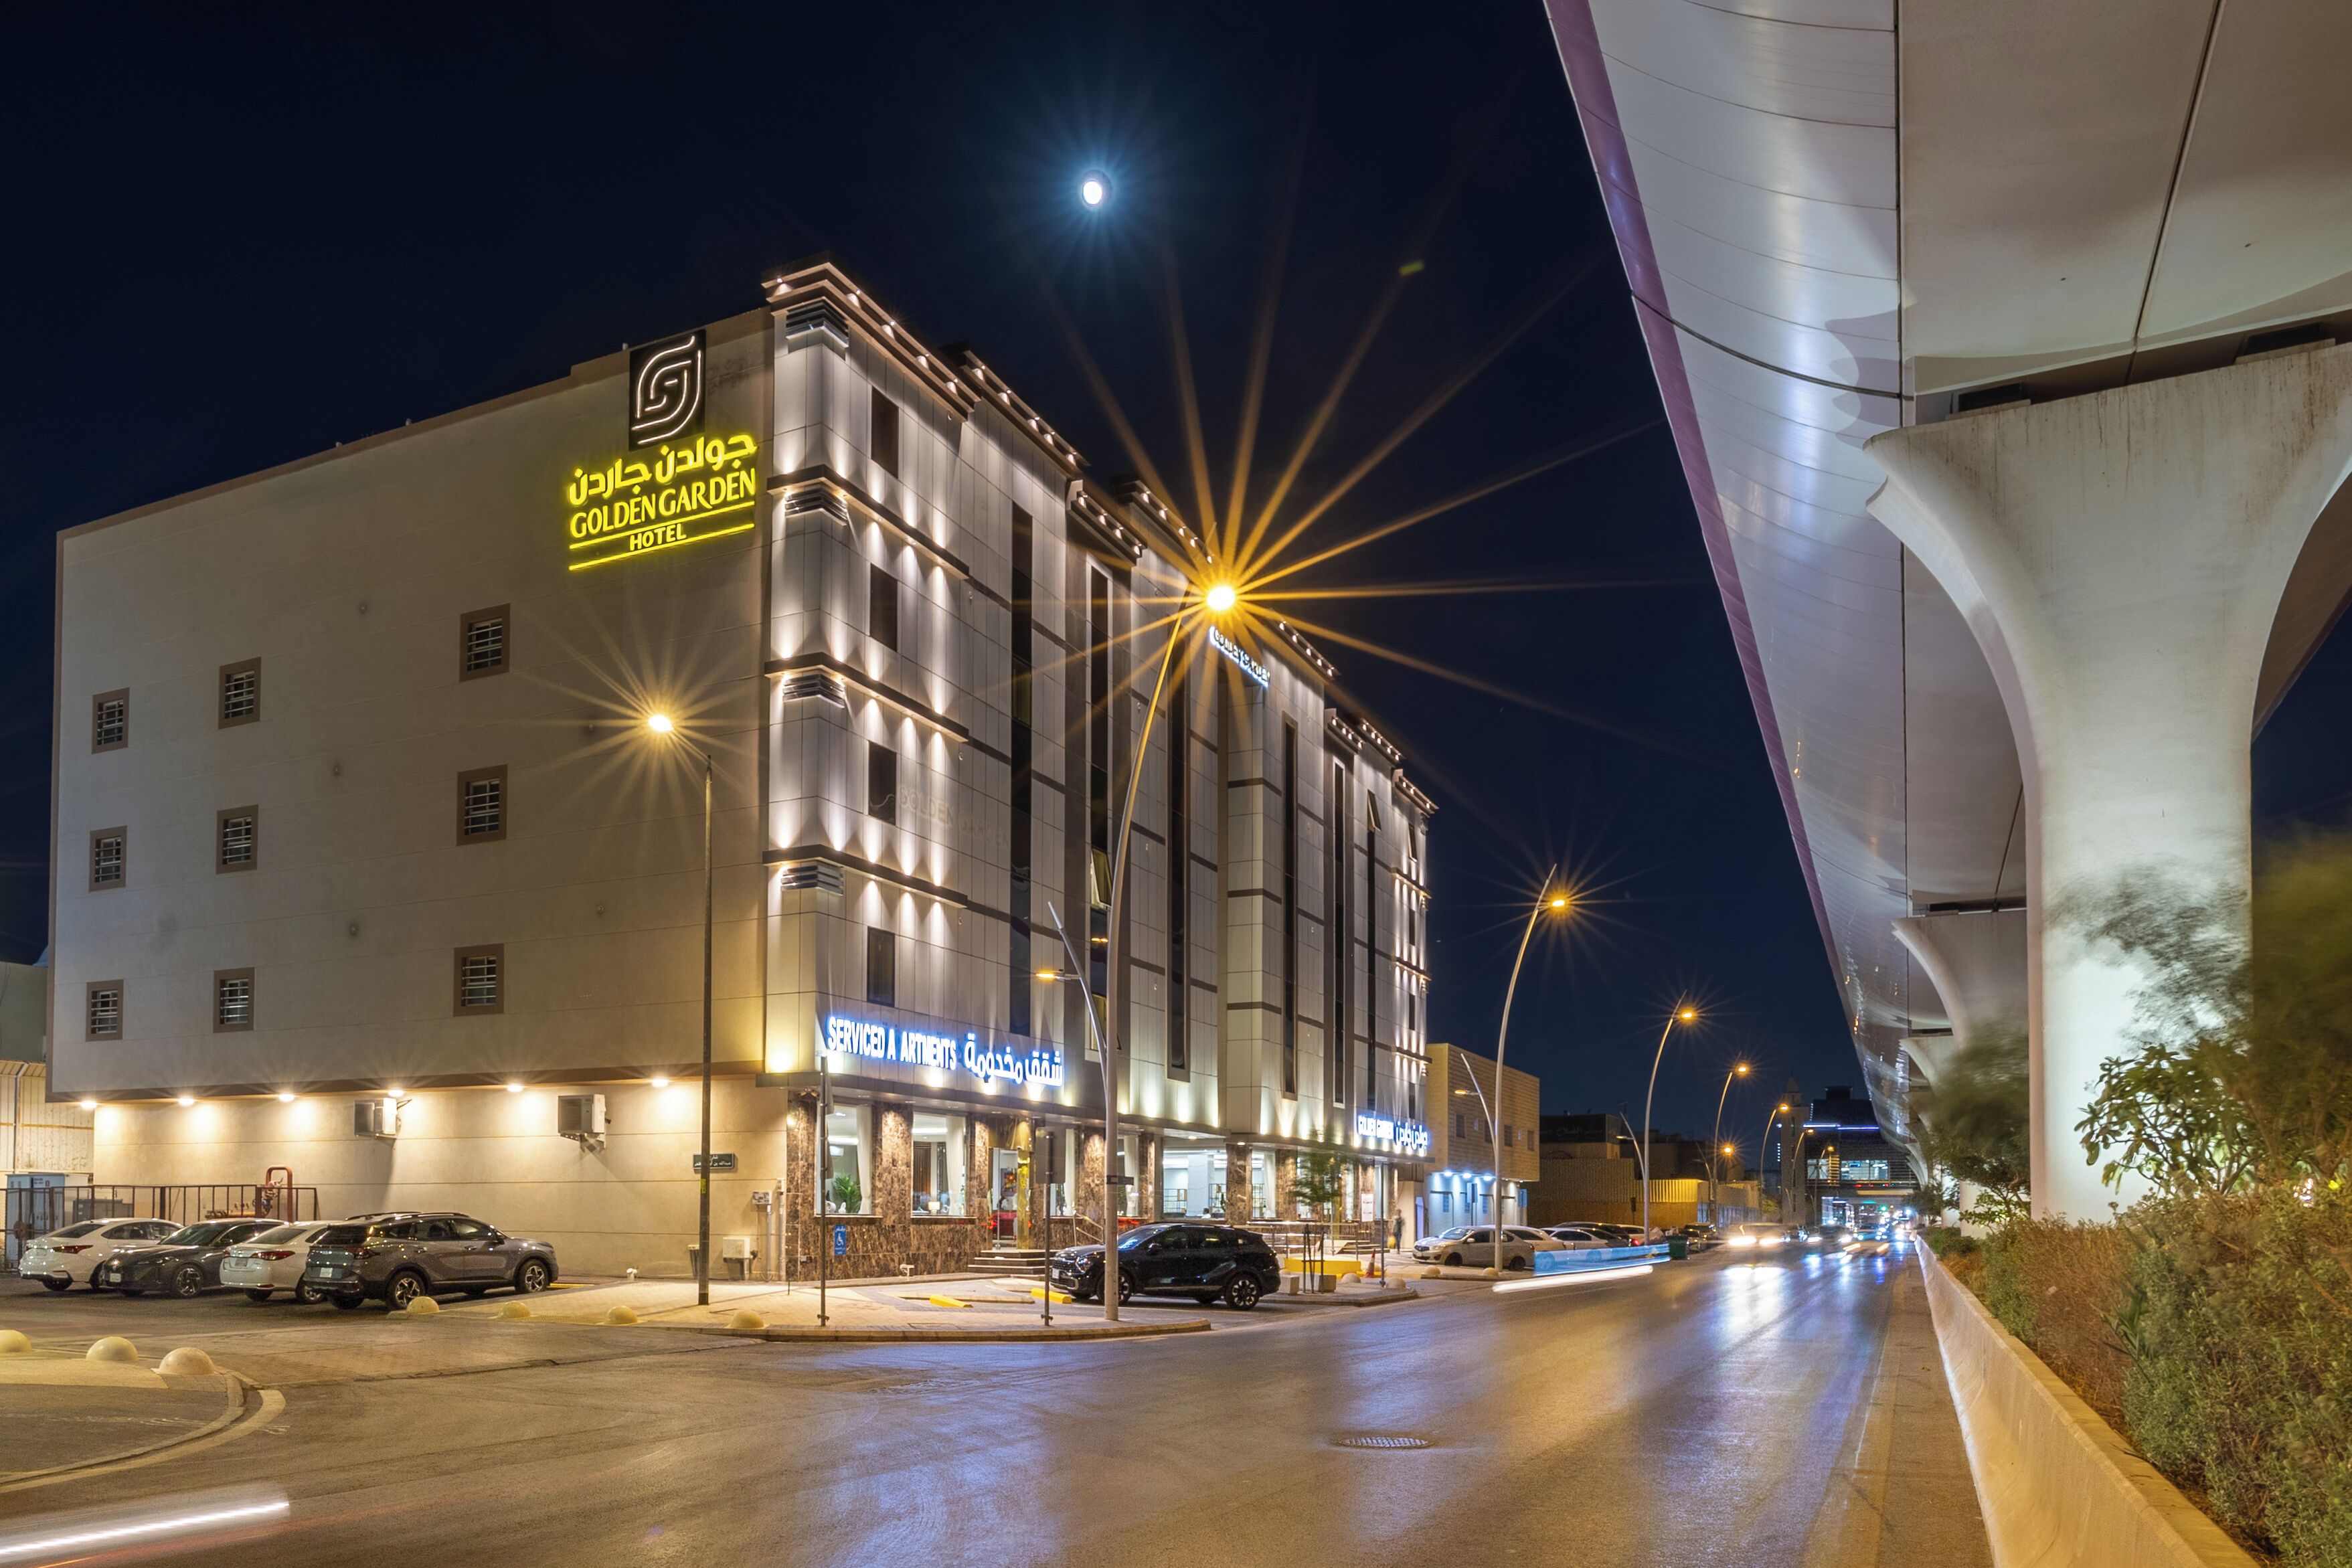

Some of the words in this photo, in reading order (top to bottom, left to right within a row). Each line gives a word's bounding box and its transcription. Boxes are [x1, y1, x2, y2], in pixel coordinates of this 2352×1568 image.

[655, 434, 758, 483] جولدن
[569, 459, 652, 505] جاردن
[570, 493, 655, 537] GOLDEN
[659, 468, 756, 514] GARDEN
[630, 523, 686, 551] HOTEL
[828, 1016, 886, 1058] SERVICED
[964, 1033, 1023, 1084] مخدومة
[1025, 1050, 1063, 1086] شقق
